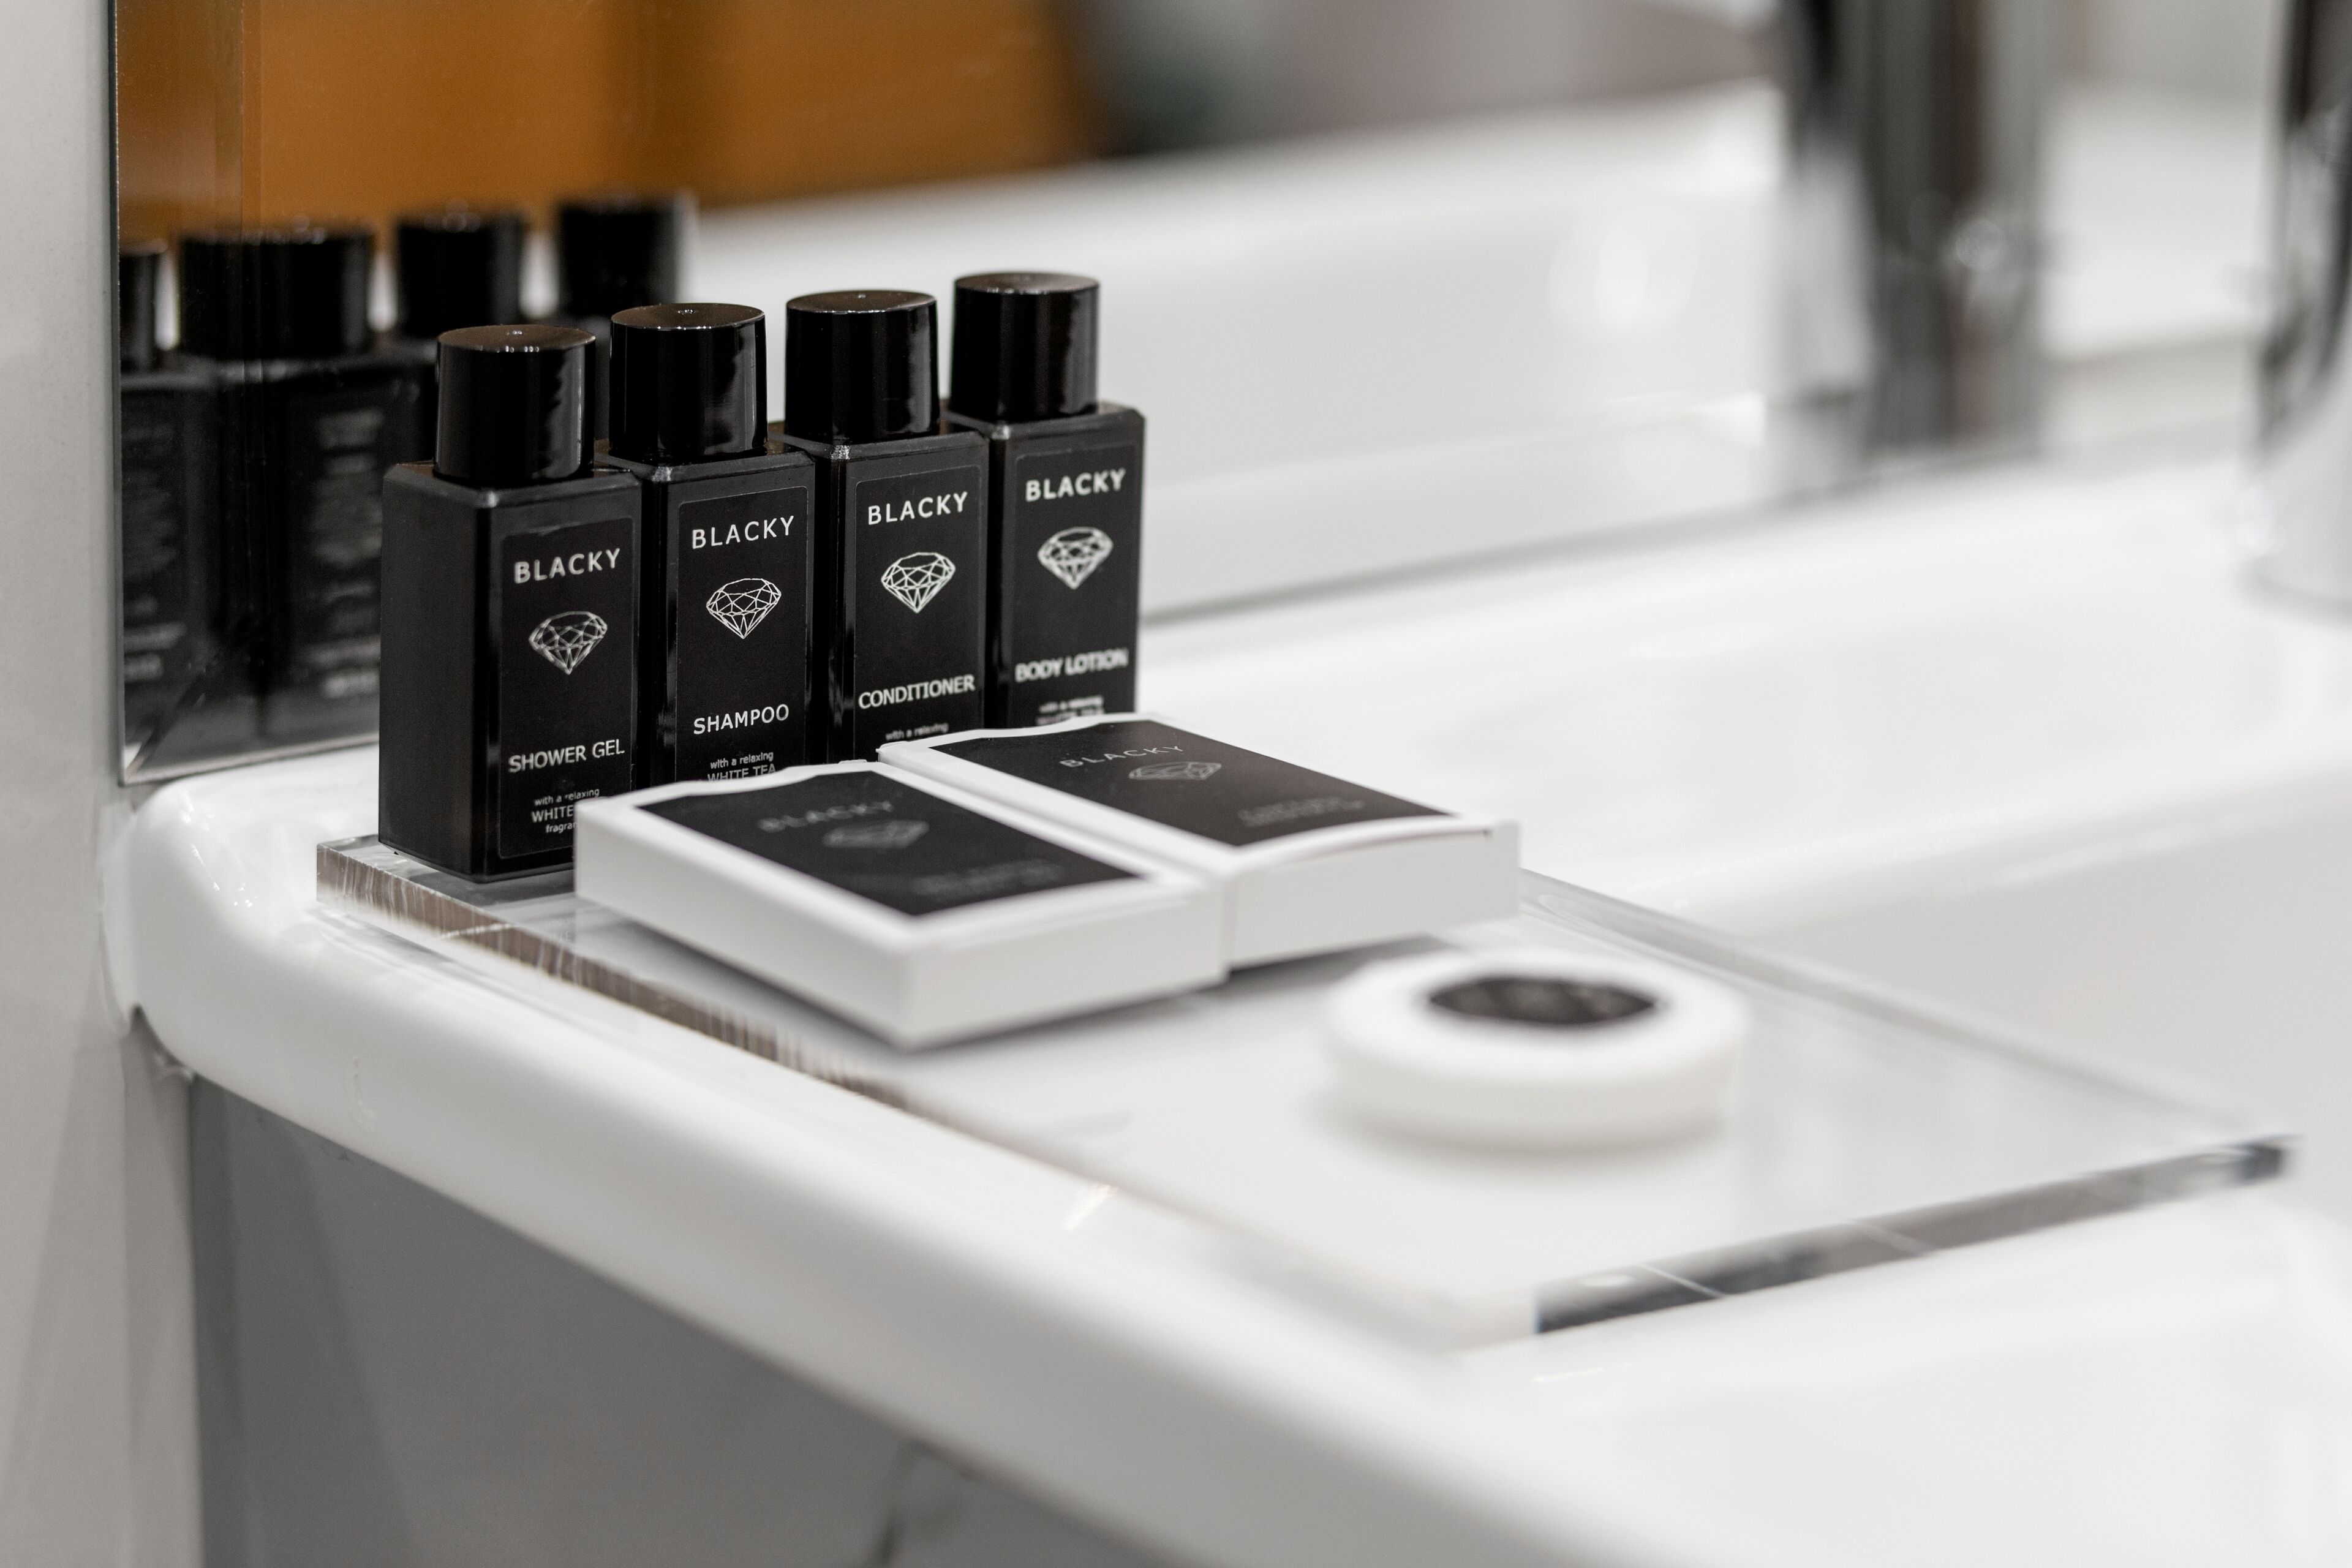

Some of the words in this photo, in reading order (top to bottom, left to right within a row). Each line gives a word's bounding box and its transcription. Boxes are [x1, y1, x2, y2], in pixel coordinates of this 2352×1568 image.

[1025, 468, 1126, 502] BLACKY
[867, 491, 968, 525] BLACKY
[692, 515, 794, 549] BLACKY
[513, 548, 620, 584] BLACKY
[1015, 657, 1063, 683] BODY
[1064, 647, 1129, 676] LOTION
[858, 674, 975, 709] CONDITIONER
[693, 704, 790, 735] SHAMPOO
[508, 745, 587, 773] SHOWER
[592, 739, 625, 758] GEL
[707, 768, 749, 781] WHITE
[752, 763, 776, 776] TEA
[710, 758, 728, 769] with
[739, 752, 774, 765] relaxing
[1060, 745, 1183, 767] BLACKY
[534, 796, 554, 807] with
[565, 788, 600, 801] relaxing
[531, 805, 575, 823] WHITE
[546, 822, 578, 834] fragran
